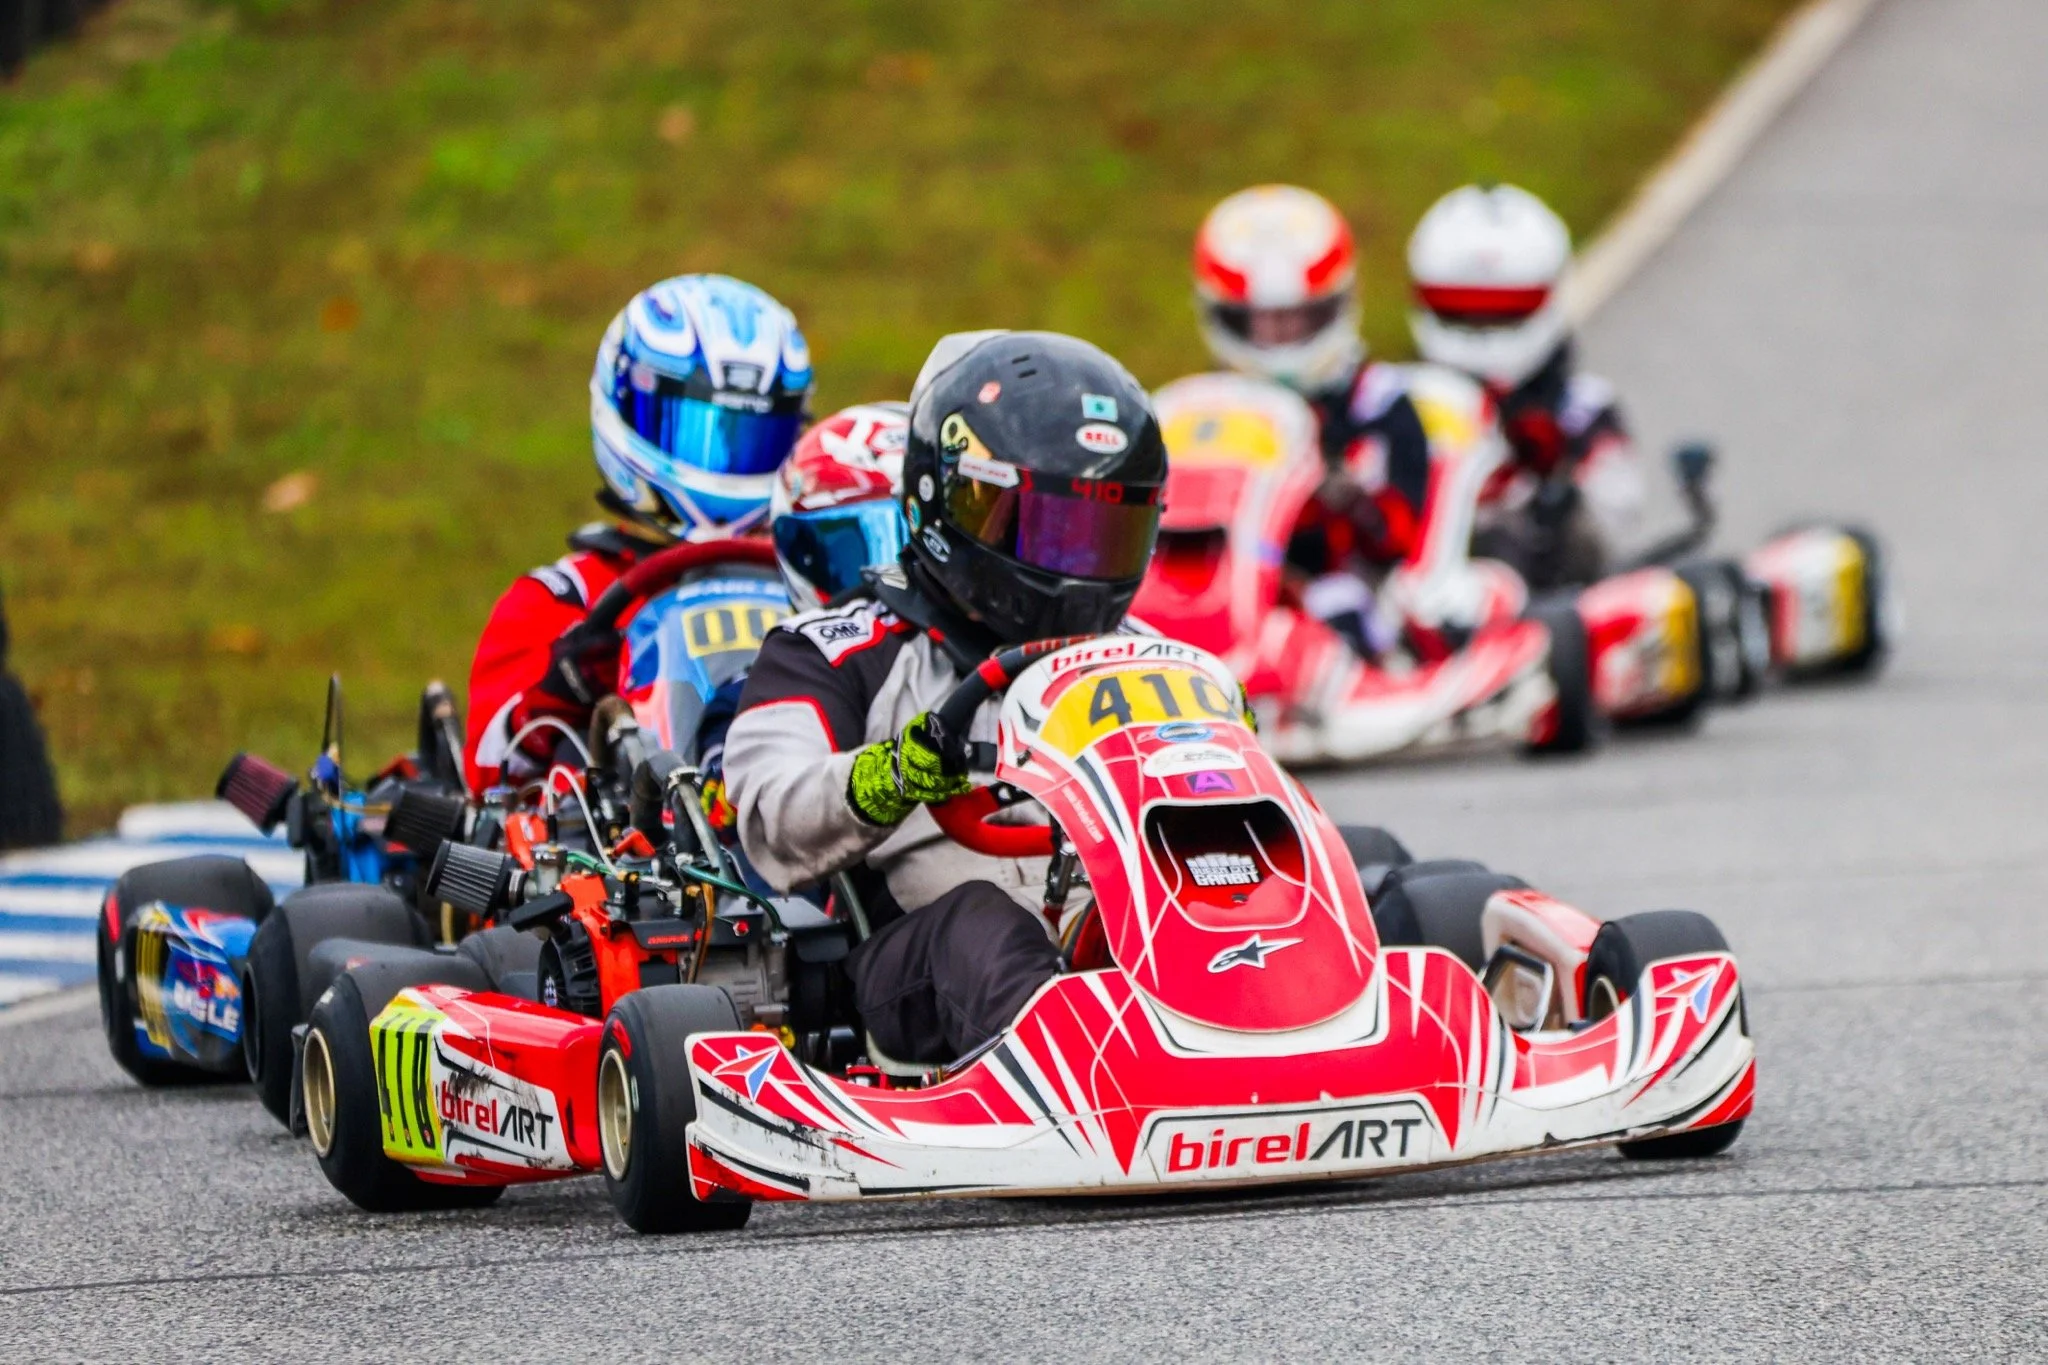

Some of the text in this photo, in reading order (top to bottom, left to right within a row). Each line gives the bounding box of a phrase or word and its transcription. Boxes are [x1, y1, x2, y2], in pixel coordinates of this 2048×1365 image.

[1052, 642, 1202, 673] birelART
[441, 1079, 554, 1150] birelART
[1166, 1117, 1423, 1174] birelART
